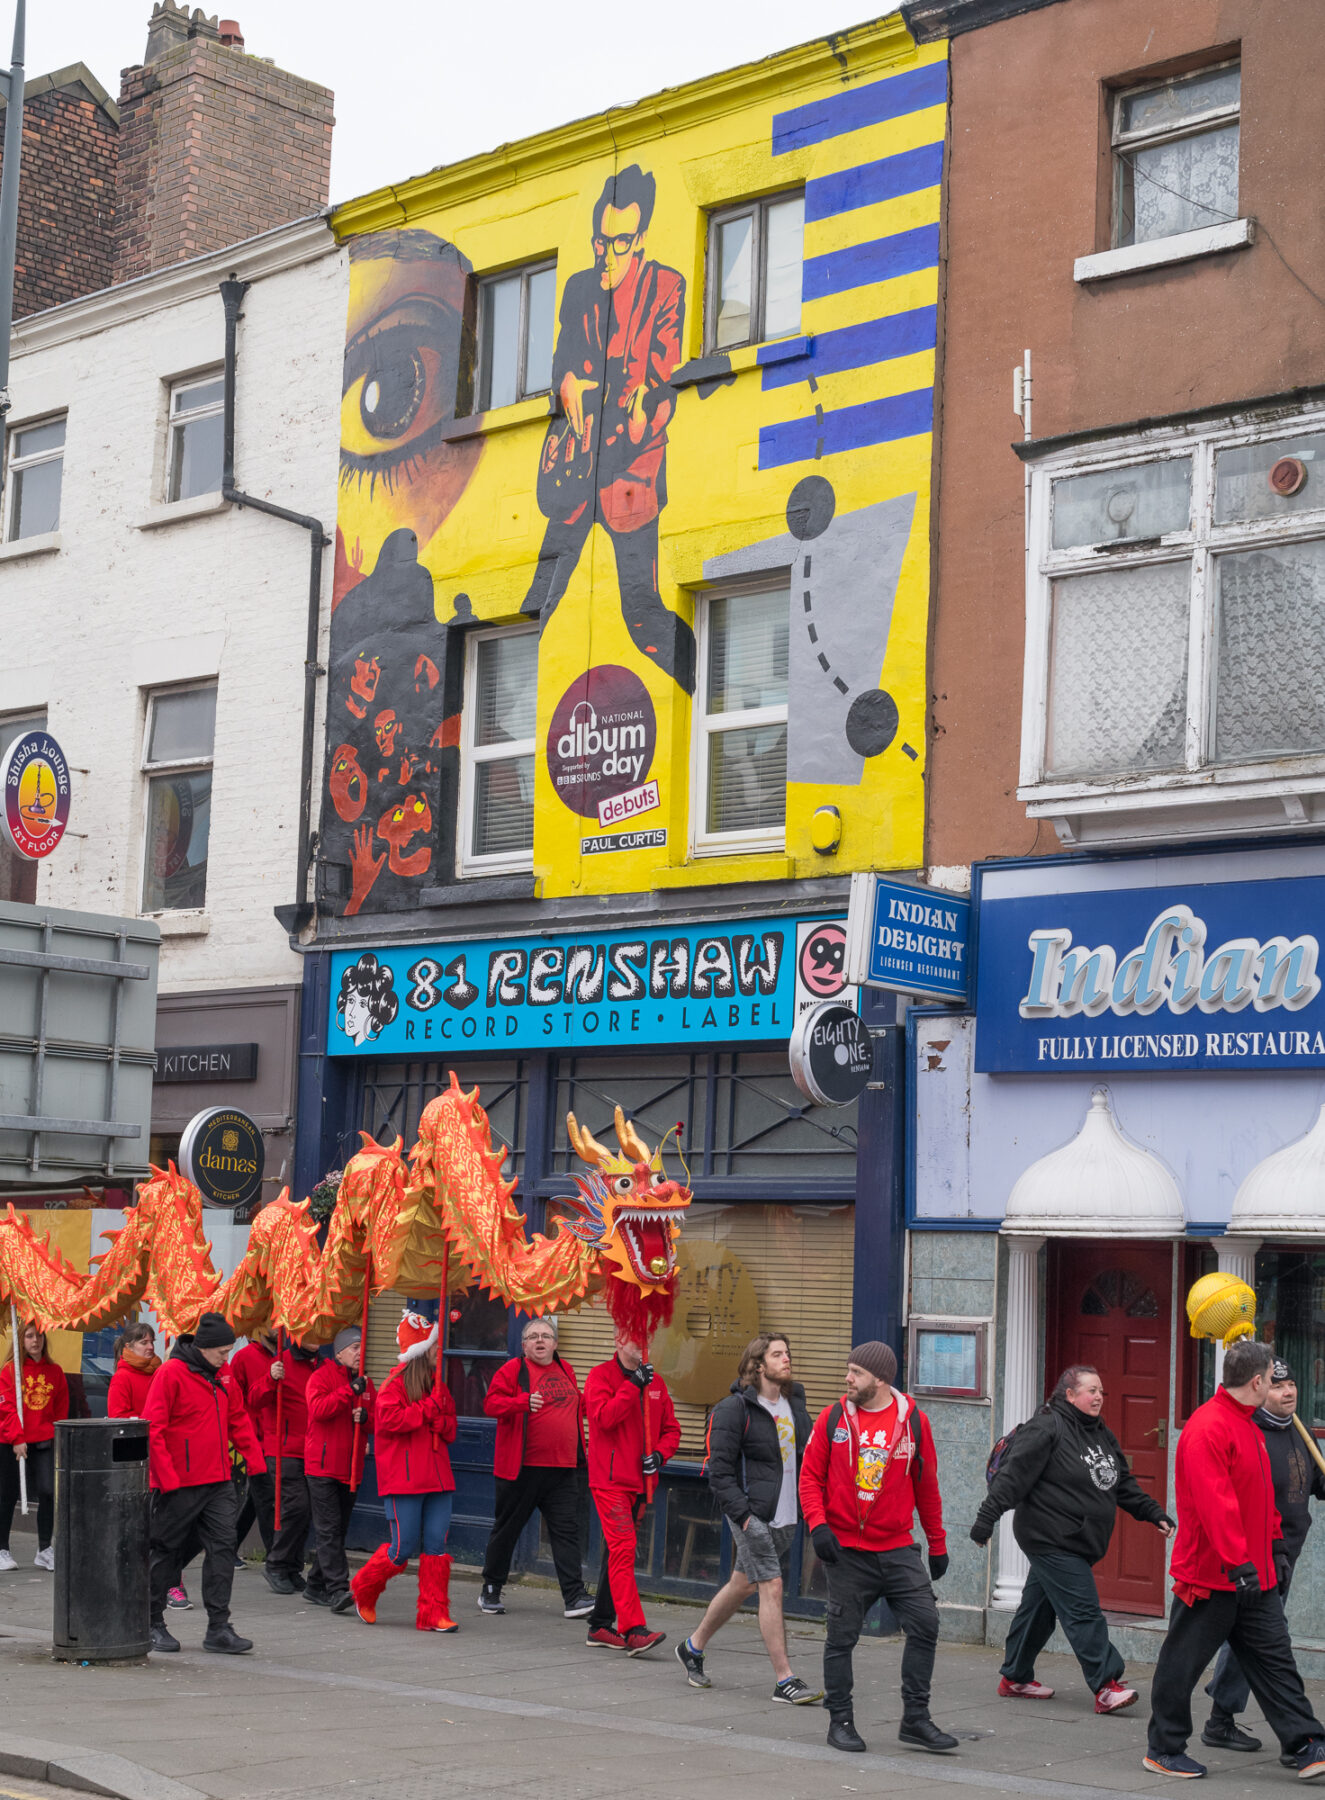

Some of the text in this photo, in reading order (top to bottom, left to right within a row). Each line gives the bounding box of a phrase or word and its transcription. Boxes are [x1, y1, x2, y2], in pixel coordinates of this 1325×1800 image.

[601, 710, 644, 724] NATIONAL
[557, 722, 646, 759] album
[8, 739, 68, 796] Shisha Lounge
[562, 762, 590, 773] Supported by
[576, 772, 601, 784] SOUNDS
[602, 751, 645, 782] day
[603, 788, 655, 821] debuts
[12, 825, 59, 852] 1ST FLOOR
[582, 830, 665, 853] PAUL CURTIS
[888, 898, 958, 932] INDIAN
[878, 925, 965, 961] DELIGHT
[406, 931, 784, 1012] 81 RENSHAW
[880, 955, 960, 981] LICENSED RESTAURANT
[1020, 910, 1317, 1012] Indian
[405, 1002, 781, 1041] RECORD STORE LABEL
[814, 1017, 860, 1046] EIGHTY
[1037, 1035, 1098, 1061] FULLY
[1101, 1034, 1199, 1060] LICENSED
[164, 1053, 231, 1073] KITCHEN
[207, 1114, 256, 1136] MEDITERRANEAN
[199, 1146, 257, 1174] damas
[212, 1189, 240, 1201] KITCHEN
